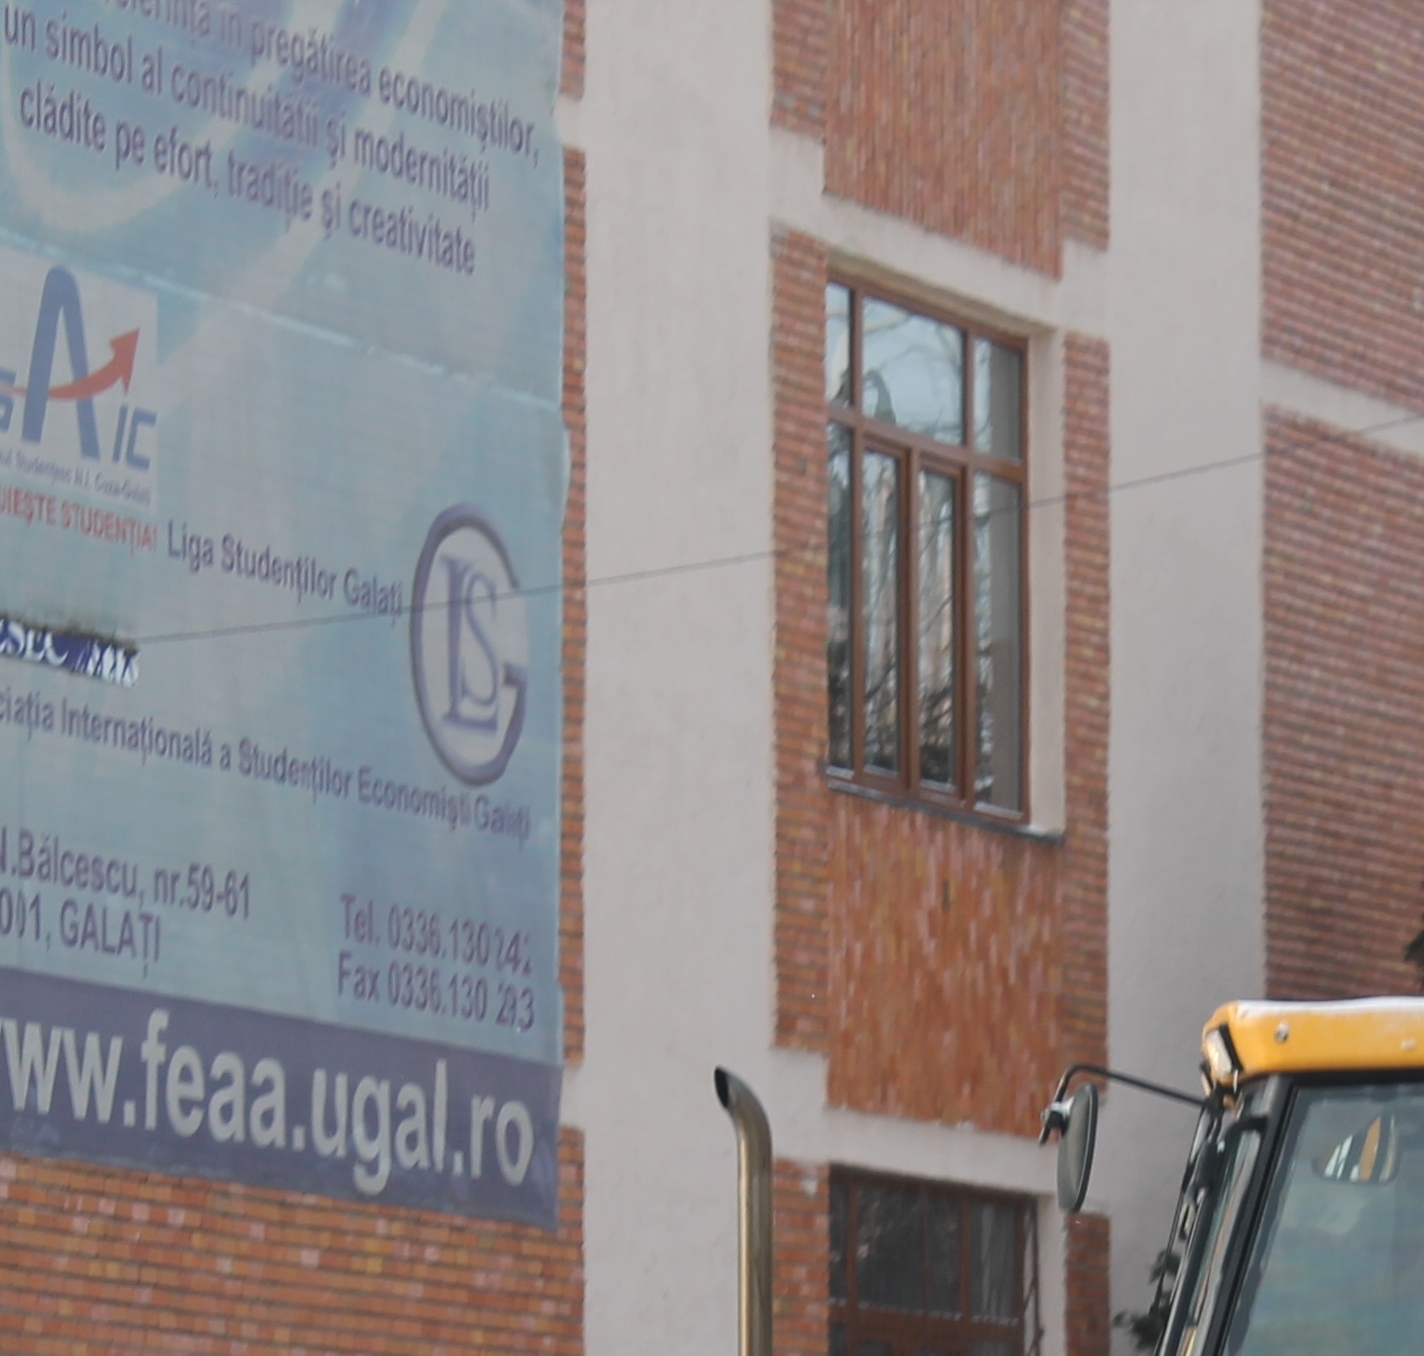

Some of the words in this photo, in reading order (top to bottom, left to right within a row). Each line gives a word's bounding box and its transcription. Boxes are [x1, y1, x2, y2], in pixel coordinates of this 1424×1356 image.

[3, 4, 36, 52] un
[44, 10, 133, 85] simbol
[141, 46, 163, 95] al
[114, 119, 146, 172] pe
[153, 124, 219, 198] efort,
[348, 199, 475, 276] creativitate
[167, 518, 215, 575] Liga
[219, 742, 232, 771] a
[339, 892, 381, 945] Tel.
[337, 950, 381, 1002] Fax
